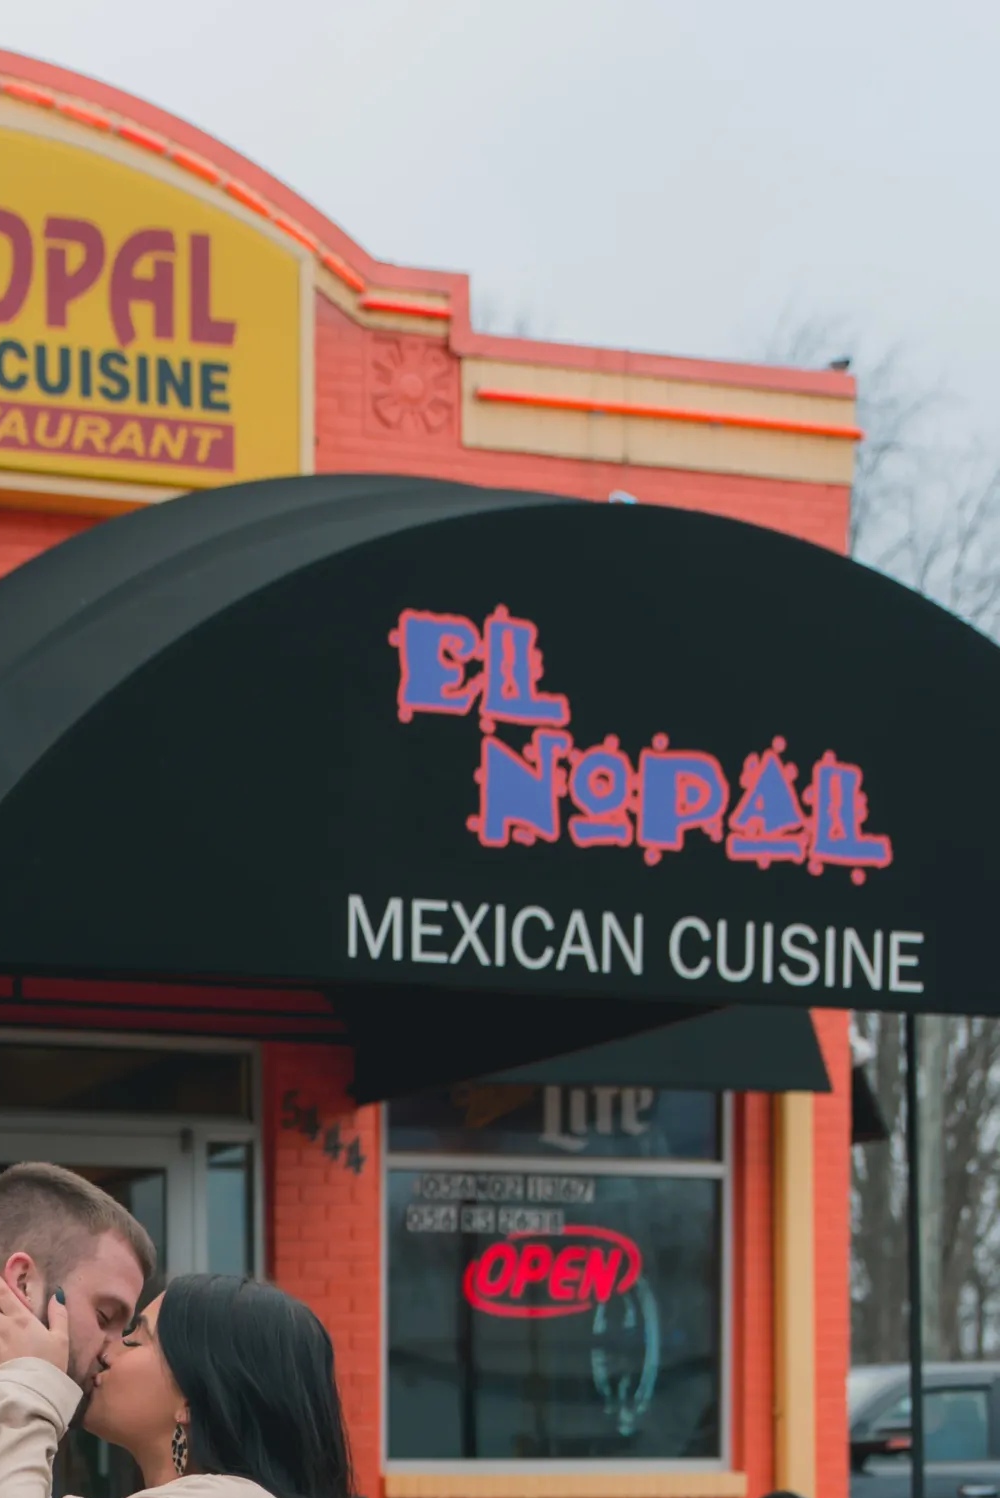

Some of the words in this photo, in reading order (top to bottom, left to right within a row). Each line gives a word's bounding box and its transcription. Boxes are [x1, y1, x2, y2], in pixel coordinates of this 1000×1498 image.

[388, 604, 570, 733] EL
[466, 729, 892, 885] NOPAL
[346, 893, 645, 975] MEXICAN
[668, 916, 926, 993] CUISINE
[281, 1088, 367, 1176] 5444
[475, 1241, 625, 1303] OPEN
